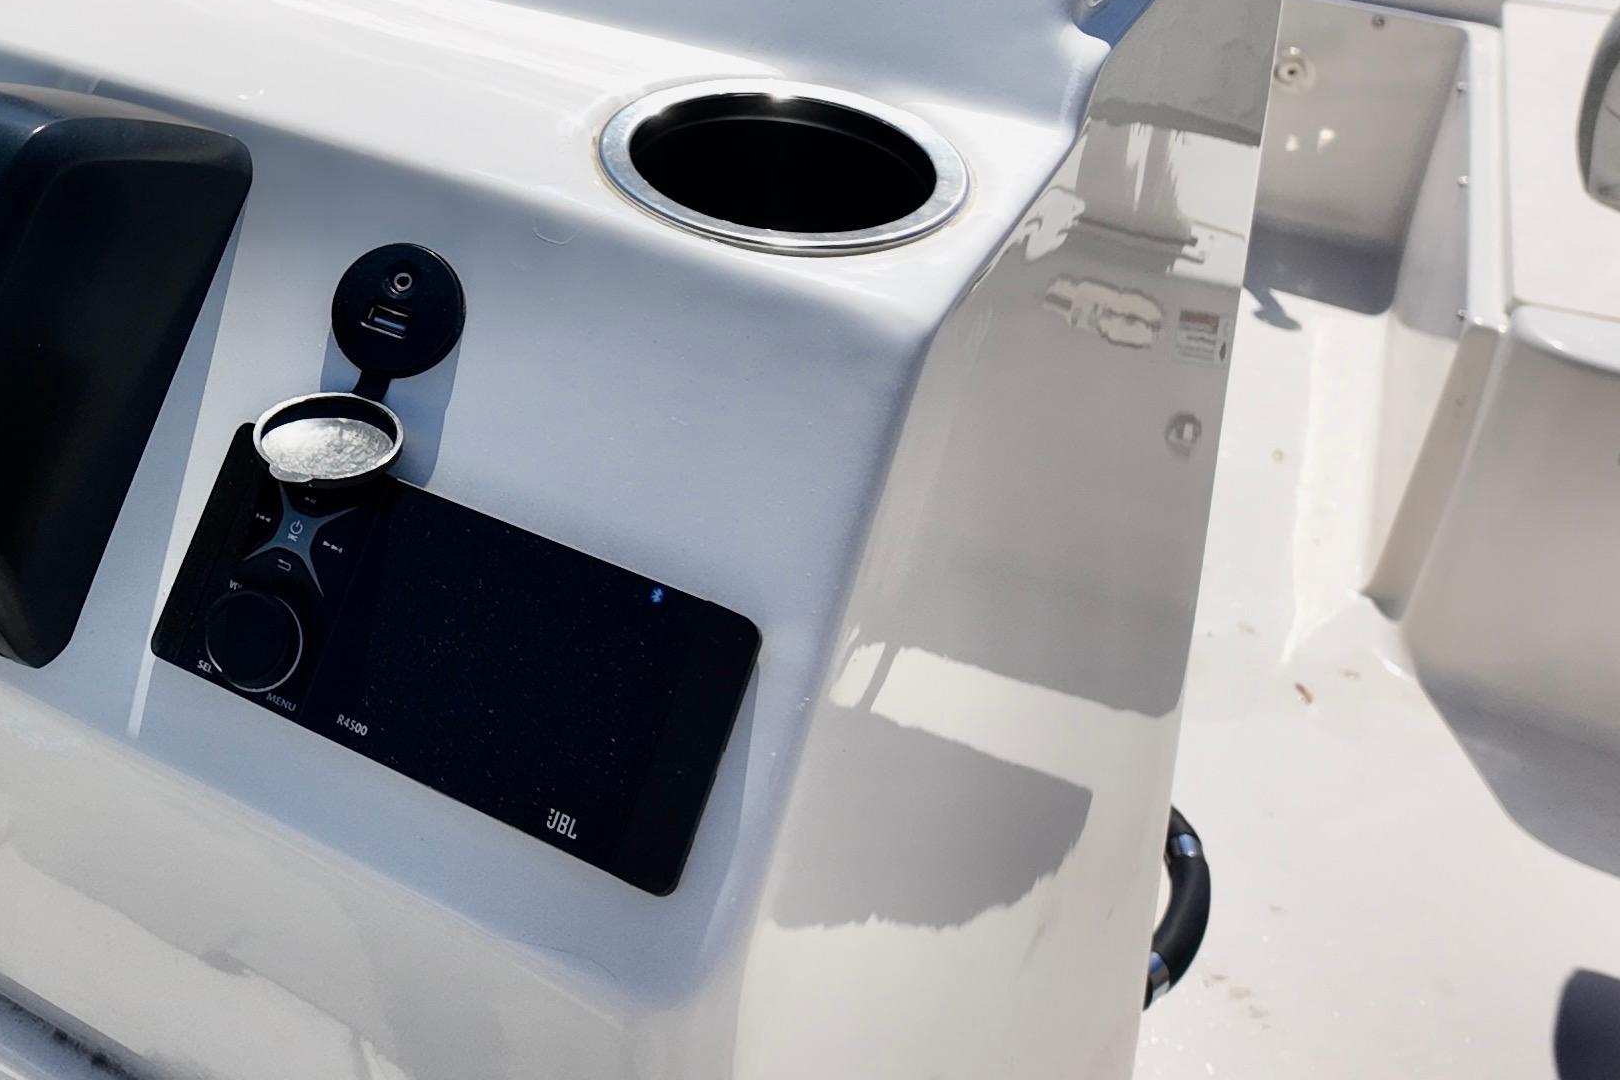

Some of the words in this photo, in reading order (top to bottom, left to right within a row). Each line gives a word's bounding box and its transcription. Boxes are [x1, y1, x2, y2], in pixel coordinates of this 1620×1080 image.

[196, 659, 213, 674] SEL
[265, 692, 297, 713] MENU
[336, 713, 369, 737] R4500
[546, 808, 578, 840] JBL
